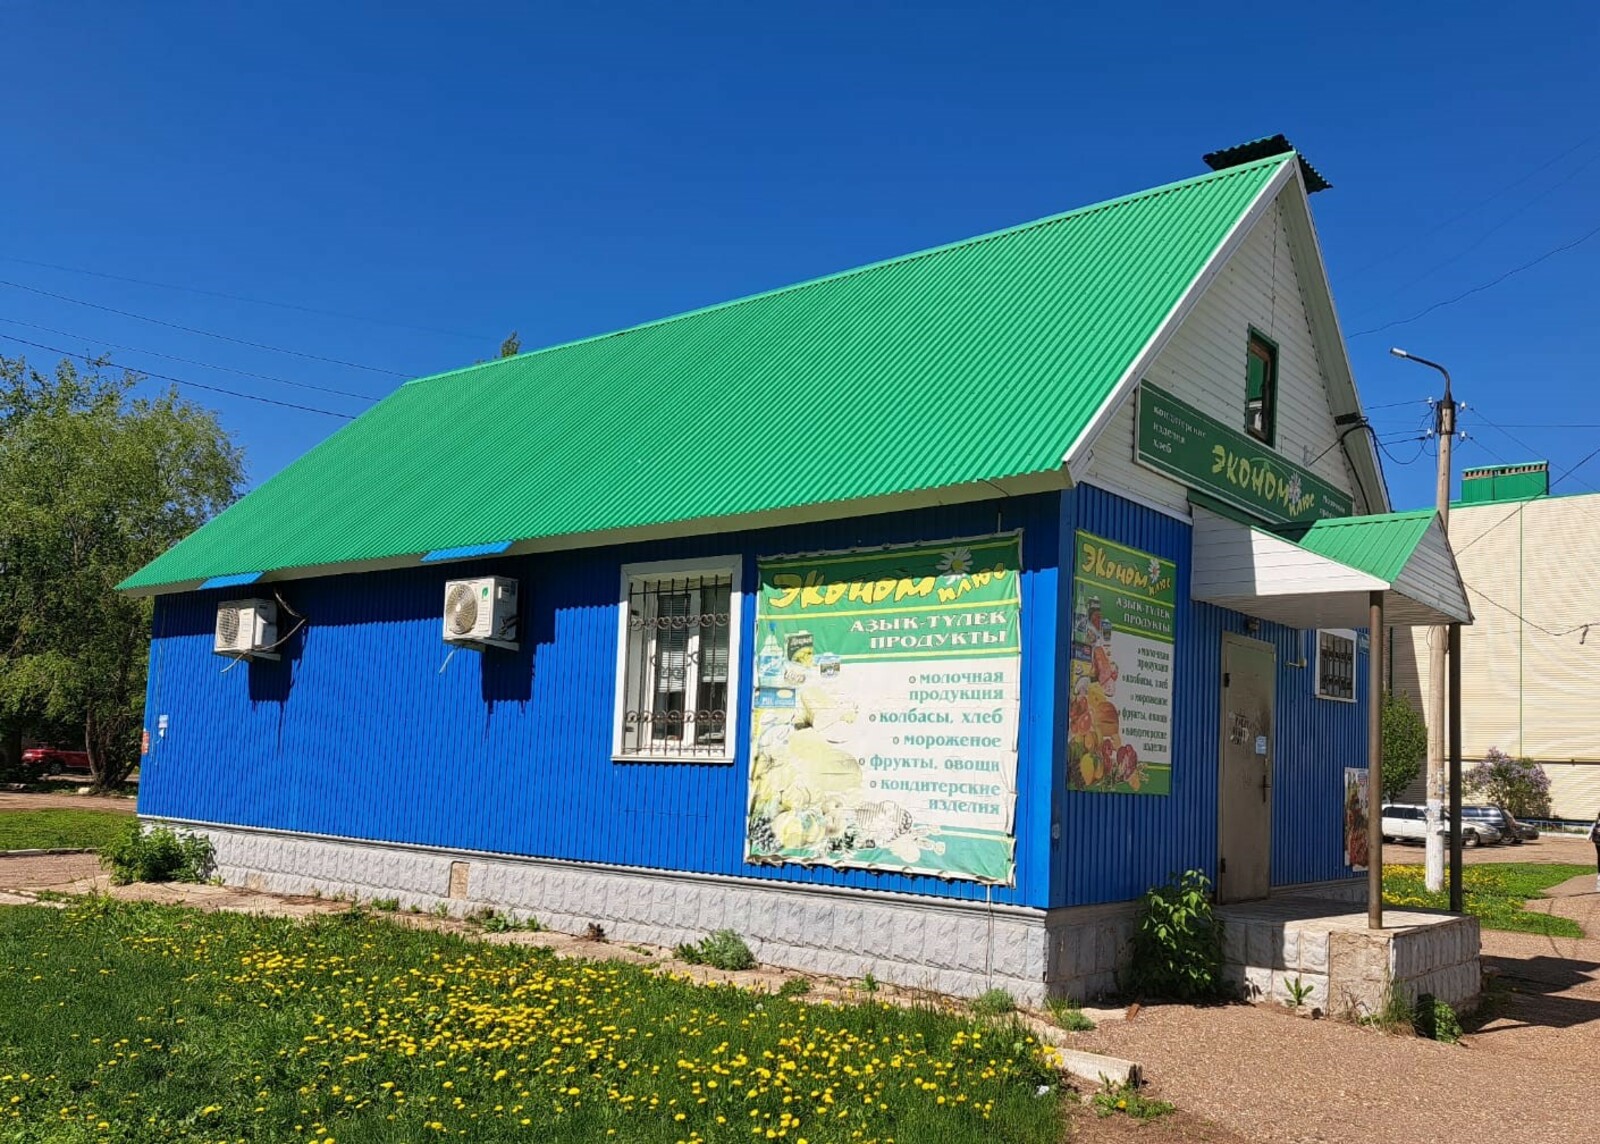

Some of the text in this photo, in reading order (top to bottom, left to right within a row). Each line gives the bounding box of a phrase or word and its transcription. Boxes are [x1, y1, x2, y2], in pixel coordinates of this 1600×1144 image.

[1123, 613, 1170, 633] ПРОДУКТЫ
[870, 630, 1007, 650] ПРОДУКТЫ
[919, 671, 1004, 684] молочная
[909, 689, 1004, 704] продукция
[961, 708, 1003, 724] хлеб
[903, 735, 1002, 749] мороженое
[944, 758, 1000, 772] овощи
[880, 779, 1001, 797] кондитерские
[929, 799, 1000, 815] изделия
